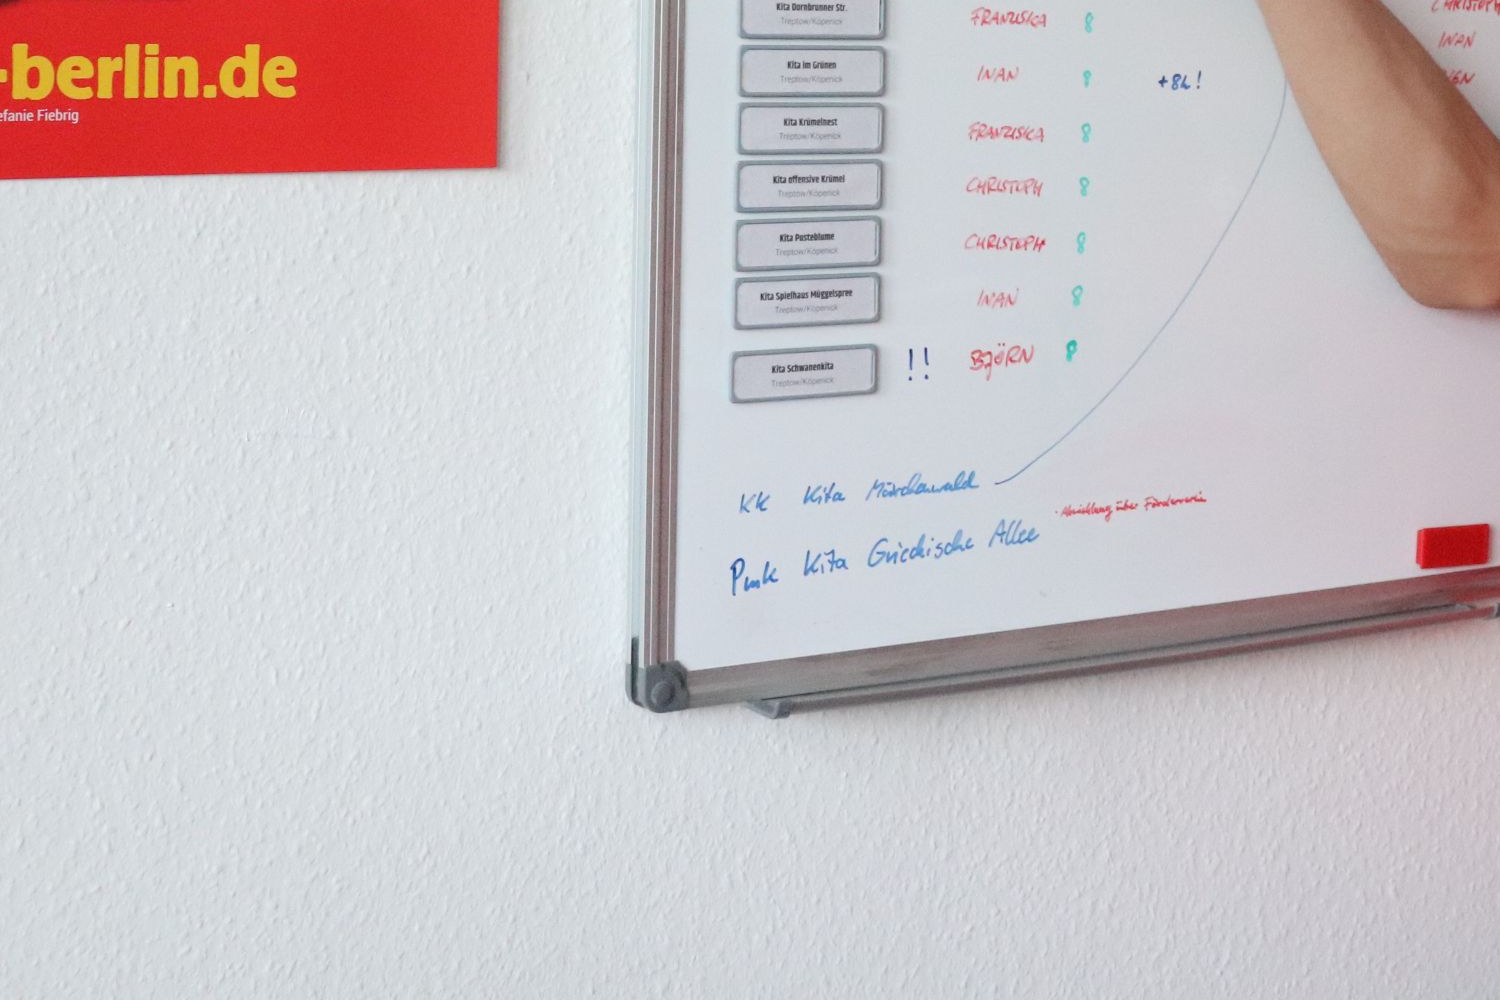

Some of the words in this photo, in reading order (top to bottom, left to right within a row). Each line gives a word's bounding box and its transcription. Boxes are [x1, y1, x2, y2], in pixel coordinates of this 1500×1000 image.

[776, 3, 790, 11] Kita
[791, 3, 834, 12] Dornbrunner
[835, 3, 848, 12] Str.
[970, 7, 1047, 29] FRANZISKA
[787, 61, 801, 70] Kita
[802, 61, 811, 70] im
[812, 60, 837, 70] Grünen
[37, 108, 79, 124] Fiebrig
[783, 118, 797, 127] Kita
[799, 118, 838, 127] Krümelnest
[968, 123, 1046, 143] FRANZISKA
[773, 176, 787, 185] Kita
[788, 175, 820, 184] offensive
[821, 174, 845, 184] Krümel
[966, 177, 1044, 197] CHRISTOPH
[780, 234, 794, 243] Kita
[795, 233, 835, 242] Pusteblume
[964, 233, 1047, 253] CHRISTOPH
[760, 292, 774, 301] Kita
[775, 291, 809, 303] Spielhaus
[810, 289, 853, 300] Müggelspree
[771, 365, 785, 374] Kita
[787, 362, 834, 373] Schwanenkita
[970, 342, 1035, 380] BJÖRN
[803, 483, 845, 505] Kita
[866, 471, 979, 501] Märchenwald
[803, 550, 849, 577] Kita
[867, 530, 975, 567] Griechische
[988, 519, 1041, 548] Allee
